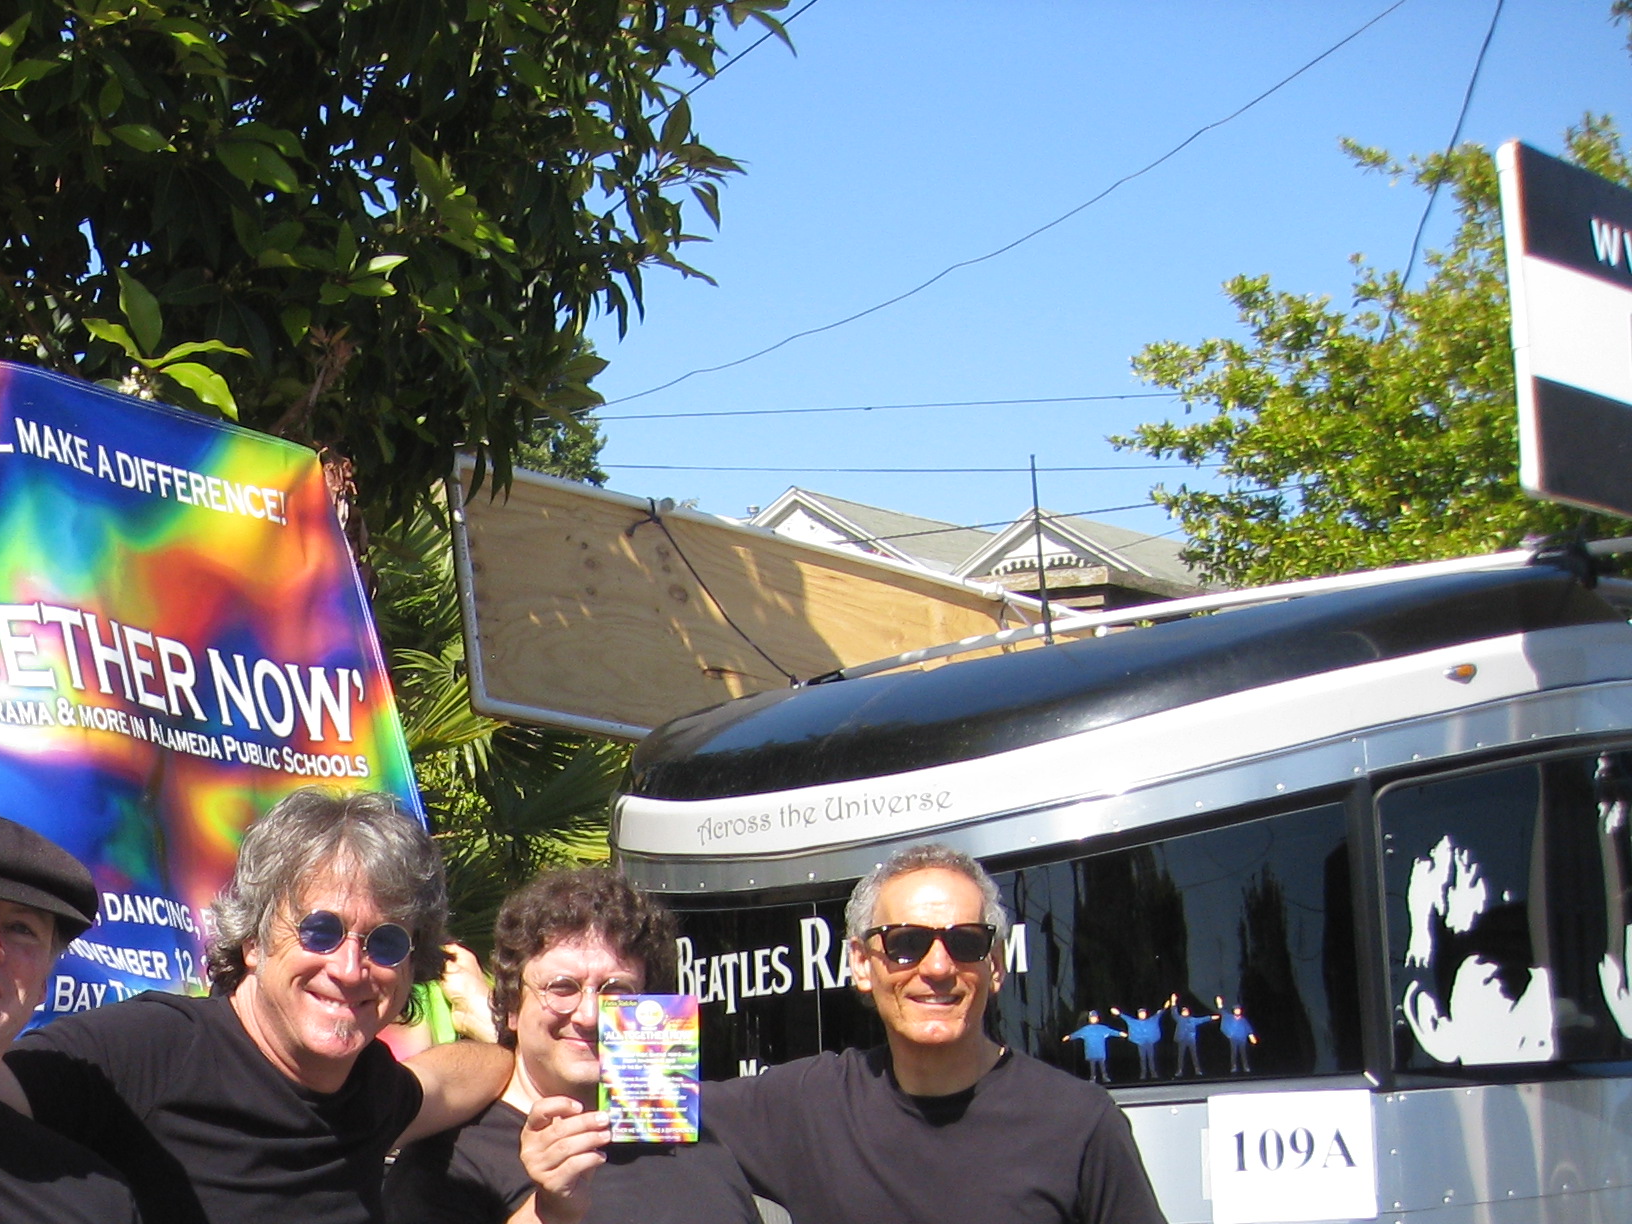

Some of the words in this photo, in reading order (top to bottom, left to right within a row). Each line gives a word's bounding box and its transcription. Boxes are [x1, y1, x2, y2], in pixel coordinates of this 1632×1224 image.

[14, 417, 94, 475] MAKE
[98, 445, 116, 482] A
[116, 450, 288, 526] DIFFERENCE!
[57, 697, 76, 727] &
[78, 703, 130, 734] MORE
[130, 714, 147, 741] IN
[149, 717, 222, 761] ALAMEDA
[223, 735, 281, 771] PUBLIC
[282, 746, 369, 778] SCHOOLS
[697, 812, 772, 846] Across
[779, 803, 817, 828] the
[825, 791, 954, 822] Universe
[103, 892, 201, 941] DANCING,
[53, 974, 107, 1013] BAY
[675, 936, 793, 1015] BEATLES
[1232, 1127, 1357, 1172] 109A
